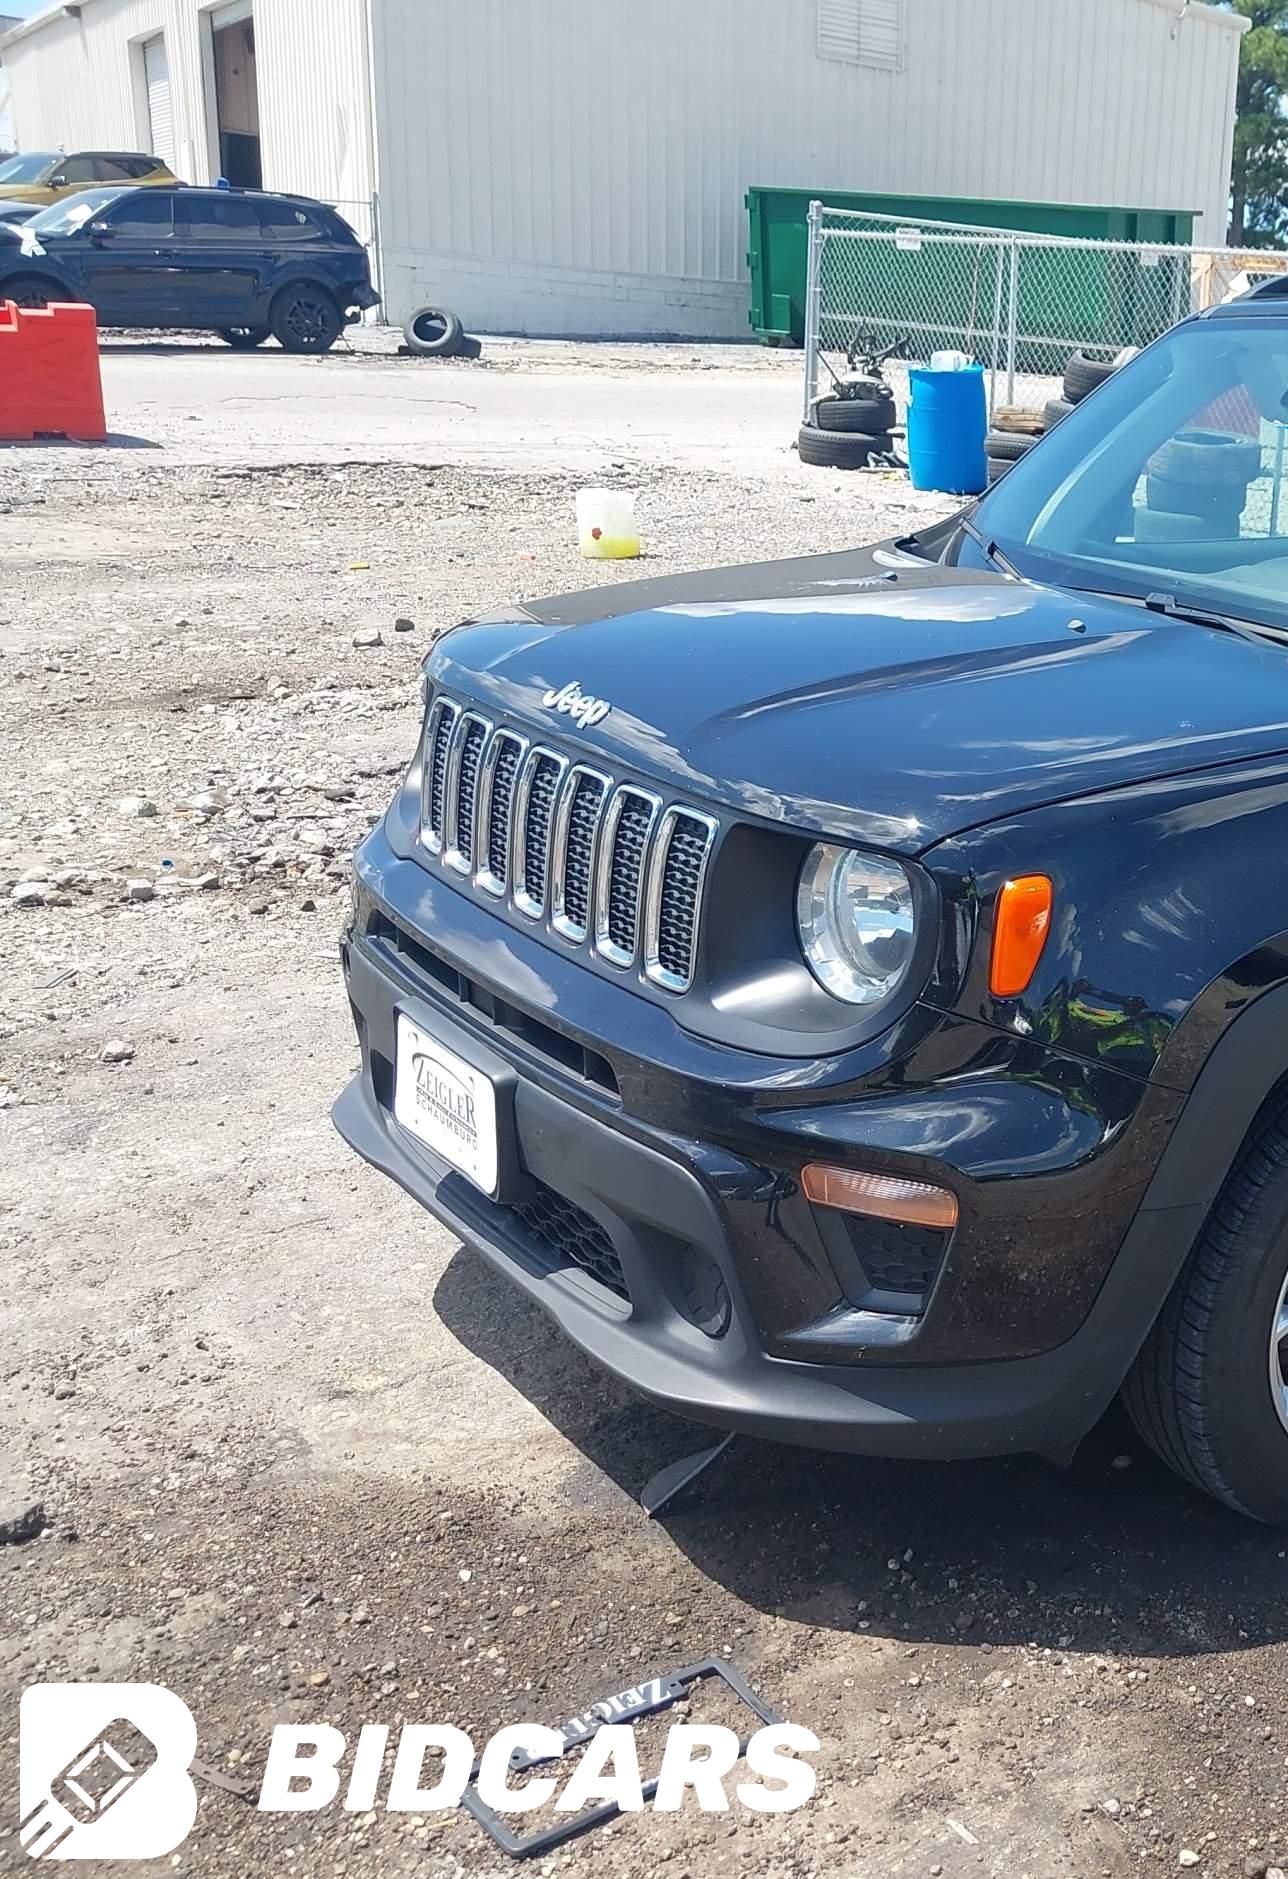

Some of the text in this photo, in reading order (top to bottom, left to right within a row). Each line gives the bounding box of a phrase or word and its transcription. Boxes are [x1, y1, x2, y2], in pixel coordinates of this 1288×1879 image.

[543, 680, 611, 730] Jeep
[415, 1059, 477, 1129] ZEIGLER
[415, 1094, 478, 1151] SCHAUMBURG
